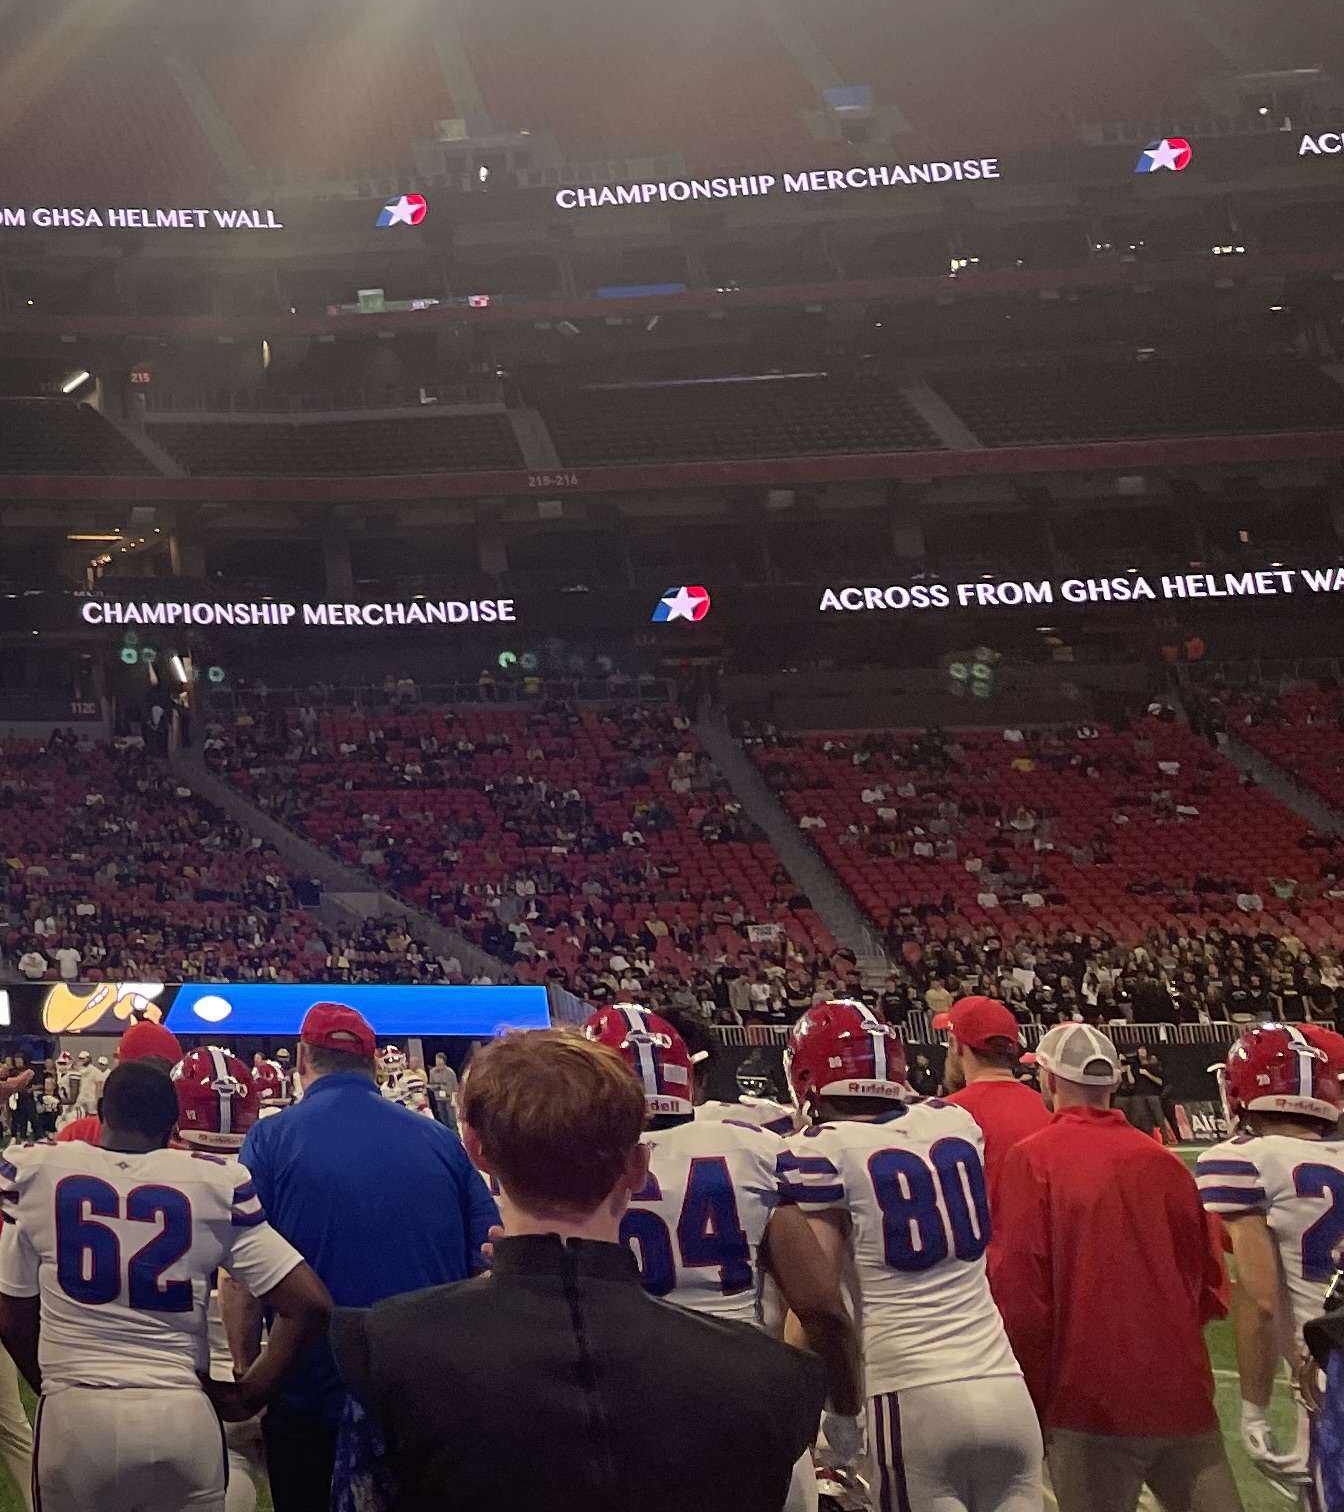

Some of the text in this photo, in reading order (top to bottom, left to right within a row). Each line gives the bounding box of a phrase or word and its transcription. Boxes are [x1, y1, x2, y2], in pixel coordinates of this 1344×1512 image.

[1299, 133, 1344, 155] AC
[556, 159, 1001, 209] CHAMPIONSHIP MERCHANDISE
[33, 209, 104, 228] GHSA
[108, 209, 209, 229] HELMET
[213, 210, 284, 230] WALL
[820, 586, 950, 612] ACROSS
[958, 582, 1053, 607] FROM
[1062, 579, 1156, 604] GHSA
[1162, 570, 1296, 599] HELMET
[83, 599, 518, 626] CHAMPIONSHIP MERCHANDISE
[71, 702, 95, 714] 112C
[868, 1137, 993, 1271] 80
[55, 1174, 194, 1312] 62
